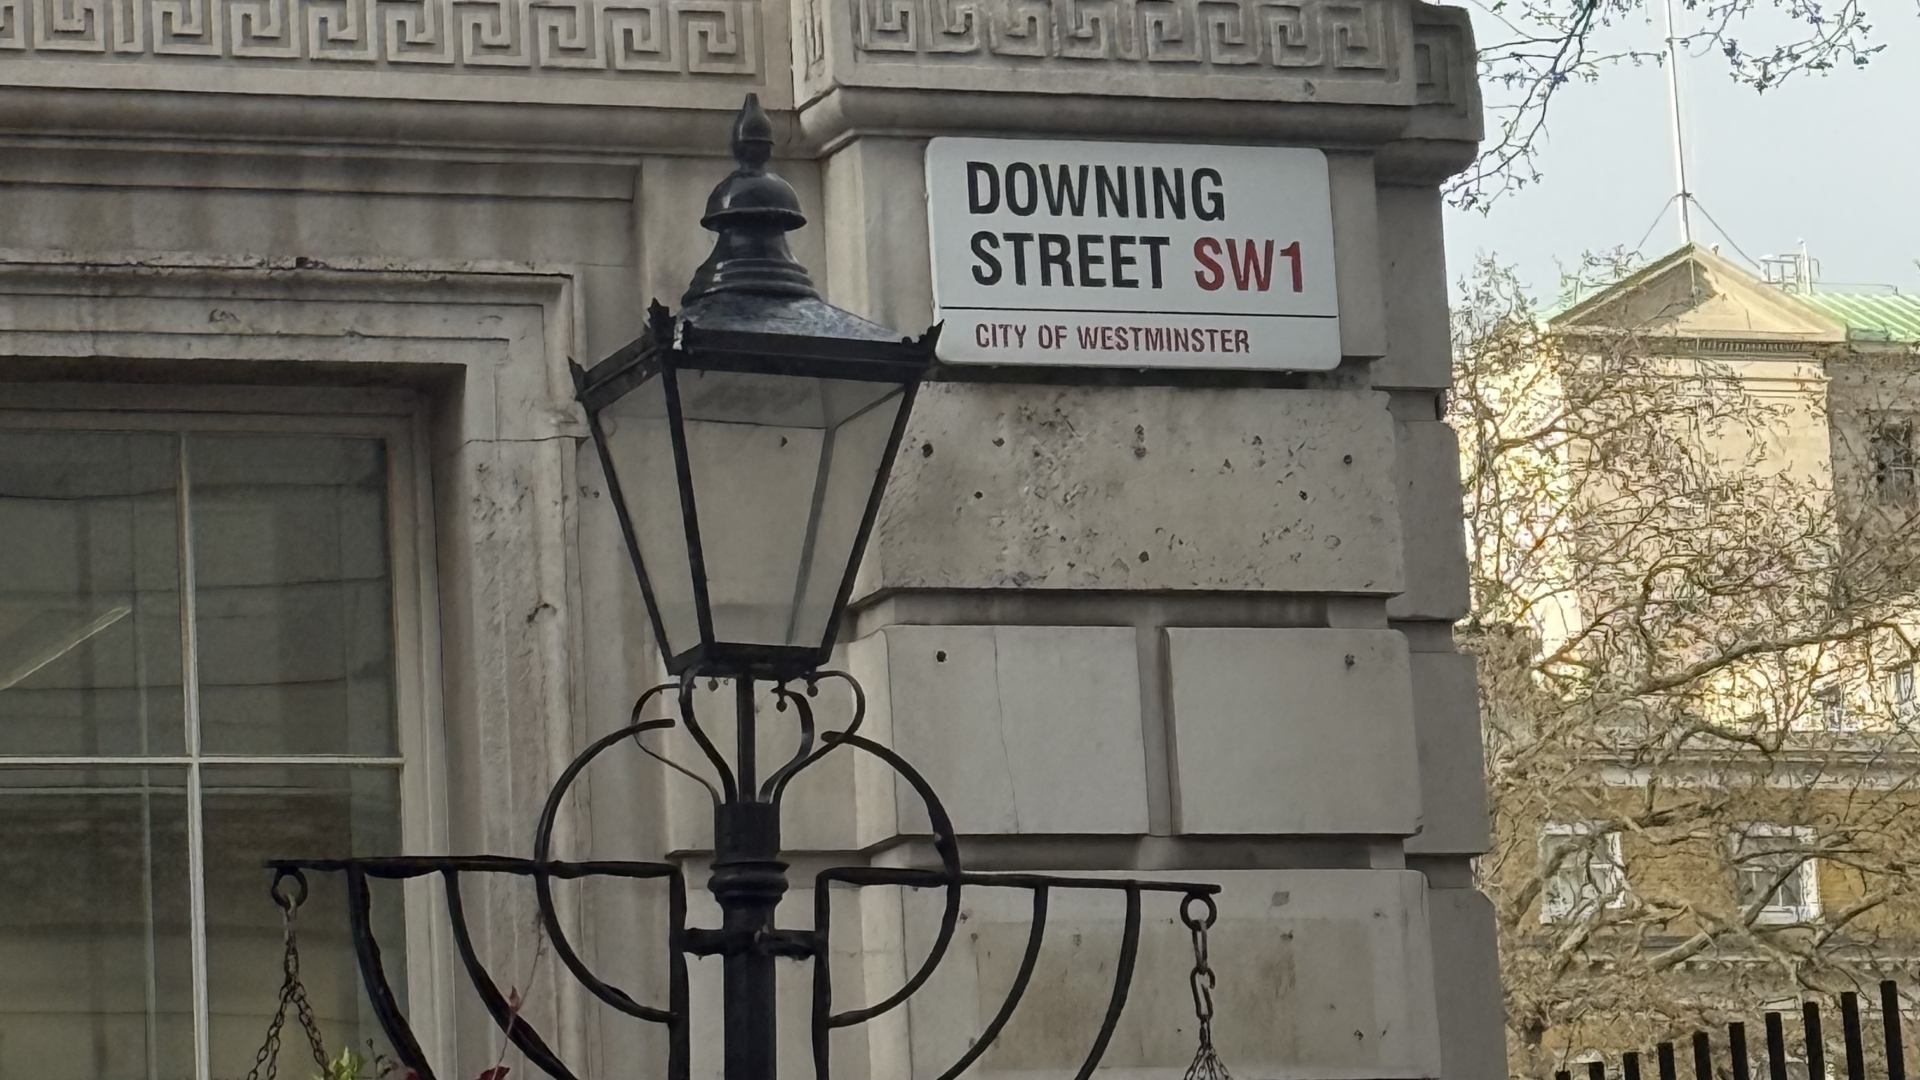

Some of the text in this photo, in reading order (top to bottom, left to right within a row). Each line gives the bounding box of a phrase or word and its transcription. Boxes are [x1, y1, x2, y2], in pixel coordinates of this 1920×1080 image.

[967, 161, 1225, 221] DOWNING
[970, 231, 1303, 292] STREET SW1
[975, 323, 1250, 353] CITY OF WESTMINSTER
